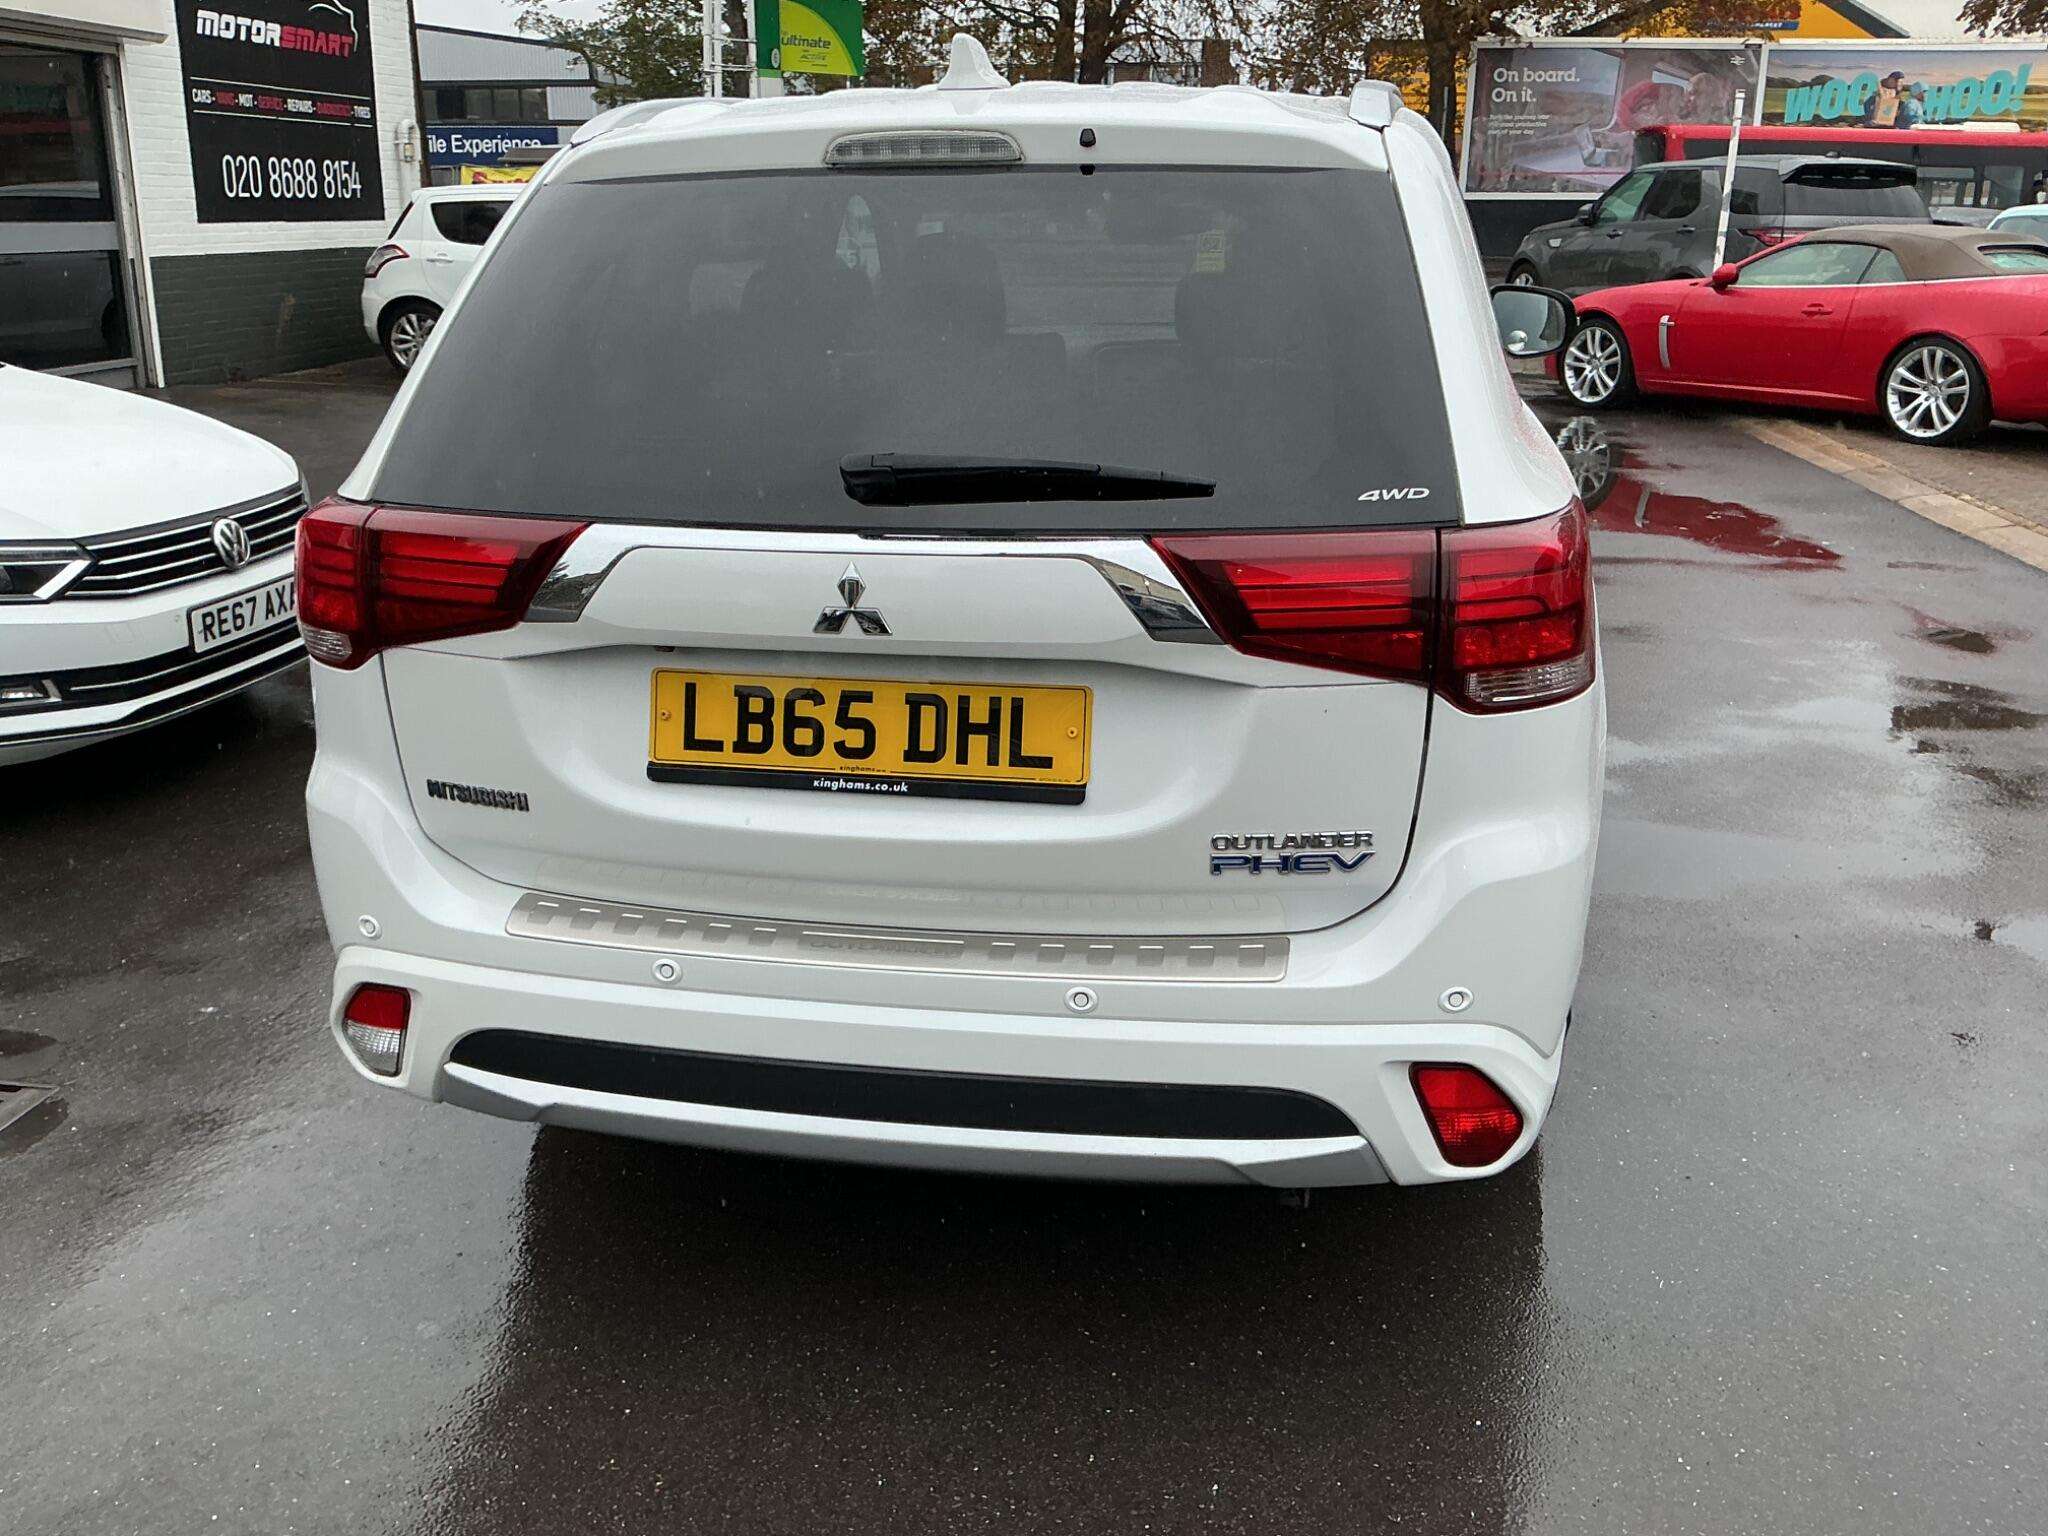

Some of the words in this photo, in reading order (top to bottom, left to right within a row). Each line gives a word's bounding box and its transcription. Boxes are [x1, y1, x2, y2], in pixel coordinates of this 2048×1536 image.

[781, 34, 832, 49] ultimate
[1493, 67, 1519, 82] On
[1522, 67, 1580, 82] board.
[192, 88, 212, 104] CARS
[238, 93, 254, 108] MOT
[1491, 87, 1517, 102] On
[1521, 87, 1537, 102] it.
[451, 135, 541, 157] Experience
[222, 155, 263, 198] 020
[268, 156, 318, 199] 8688
[323, 159, 362, 199] 8154
[1358, 488, 1430, 501] 4WD
[202, 596, 257, 643] RE67
[683, 682, 877, 760] LB65
[903, 693, 1053, 769] DHL
[426, 779, 530, 812] MITSUBISHI
[1211, 831, 1374, 850] OUTLANDER
[1211, 851, 1376, 875] PHEV
